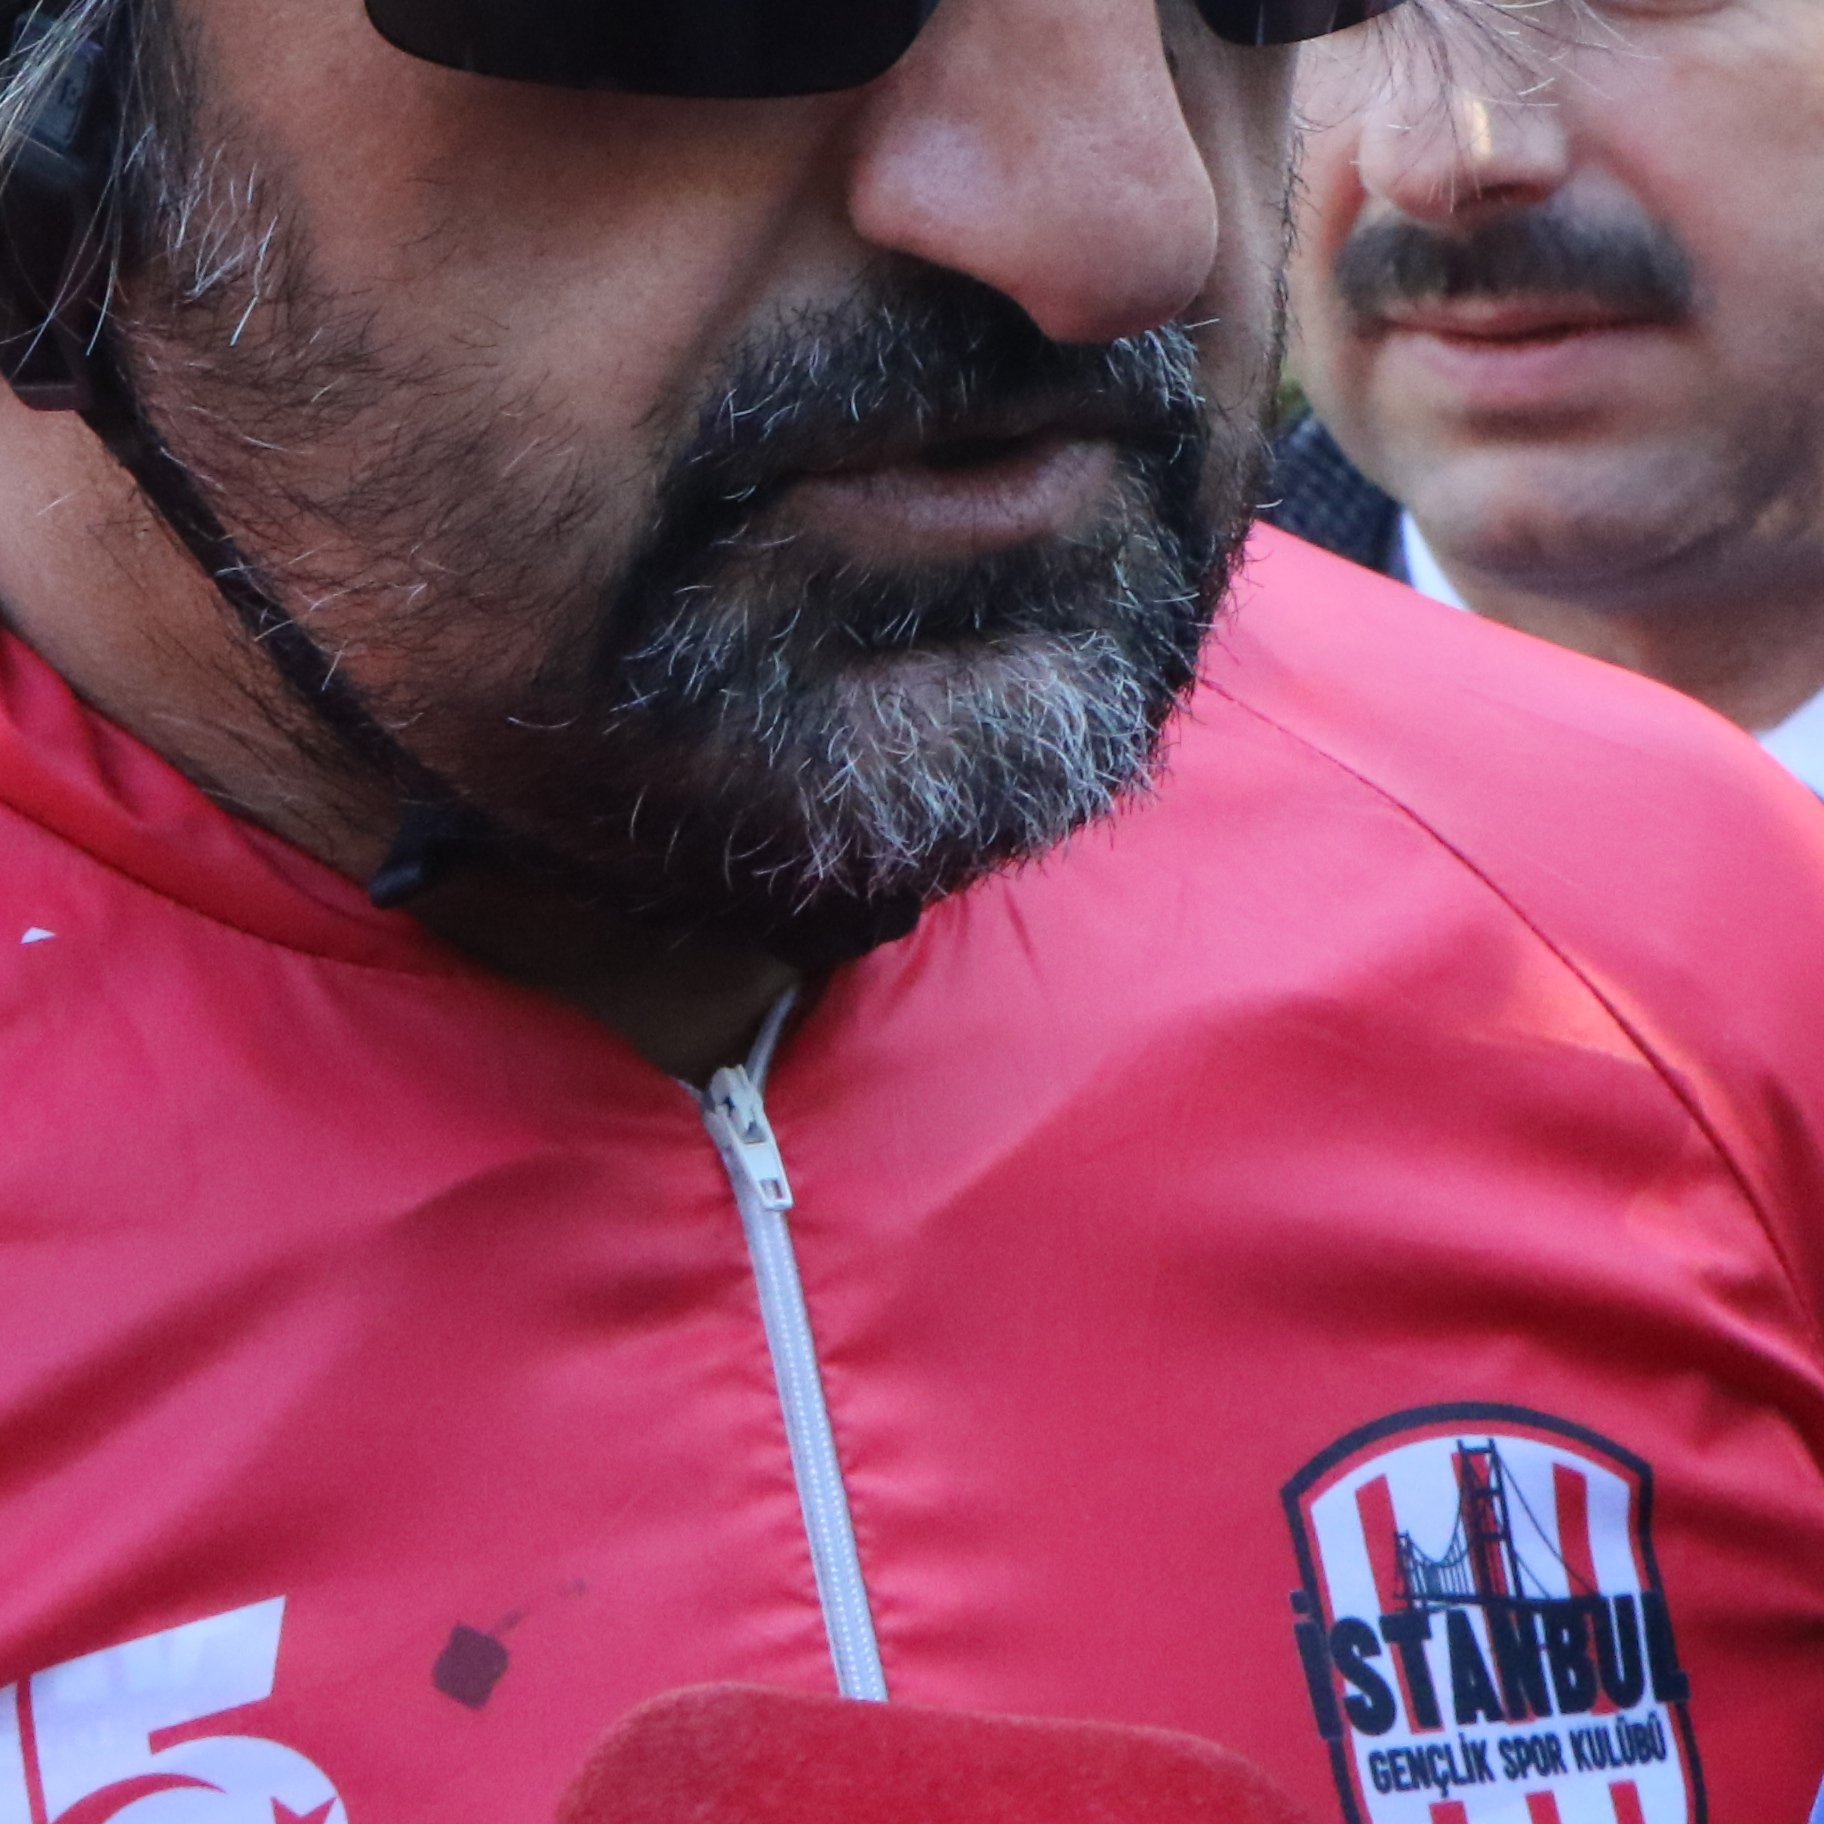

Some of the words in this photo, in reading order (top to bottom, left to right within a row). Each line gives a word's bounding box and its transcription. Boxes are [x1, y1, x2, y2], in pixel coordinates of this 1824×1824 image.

[1288, 1588, 1691, 1740] İSTANBUL
[1368, 1731, 1496, 1798] GENÇLİK
[1498, 1732, 1568, 1781] SPOR
